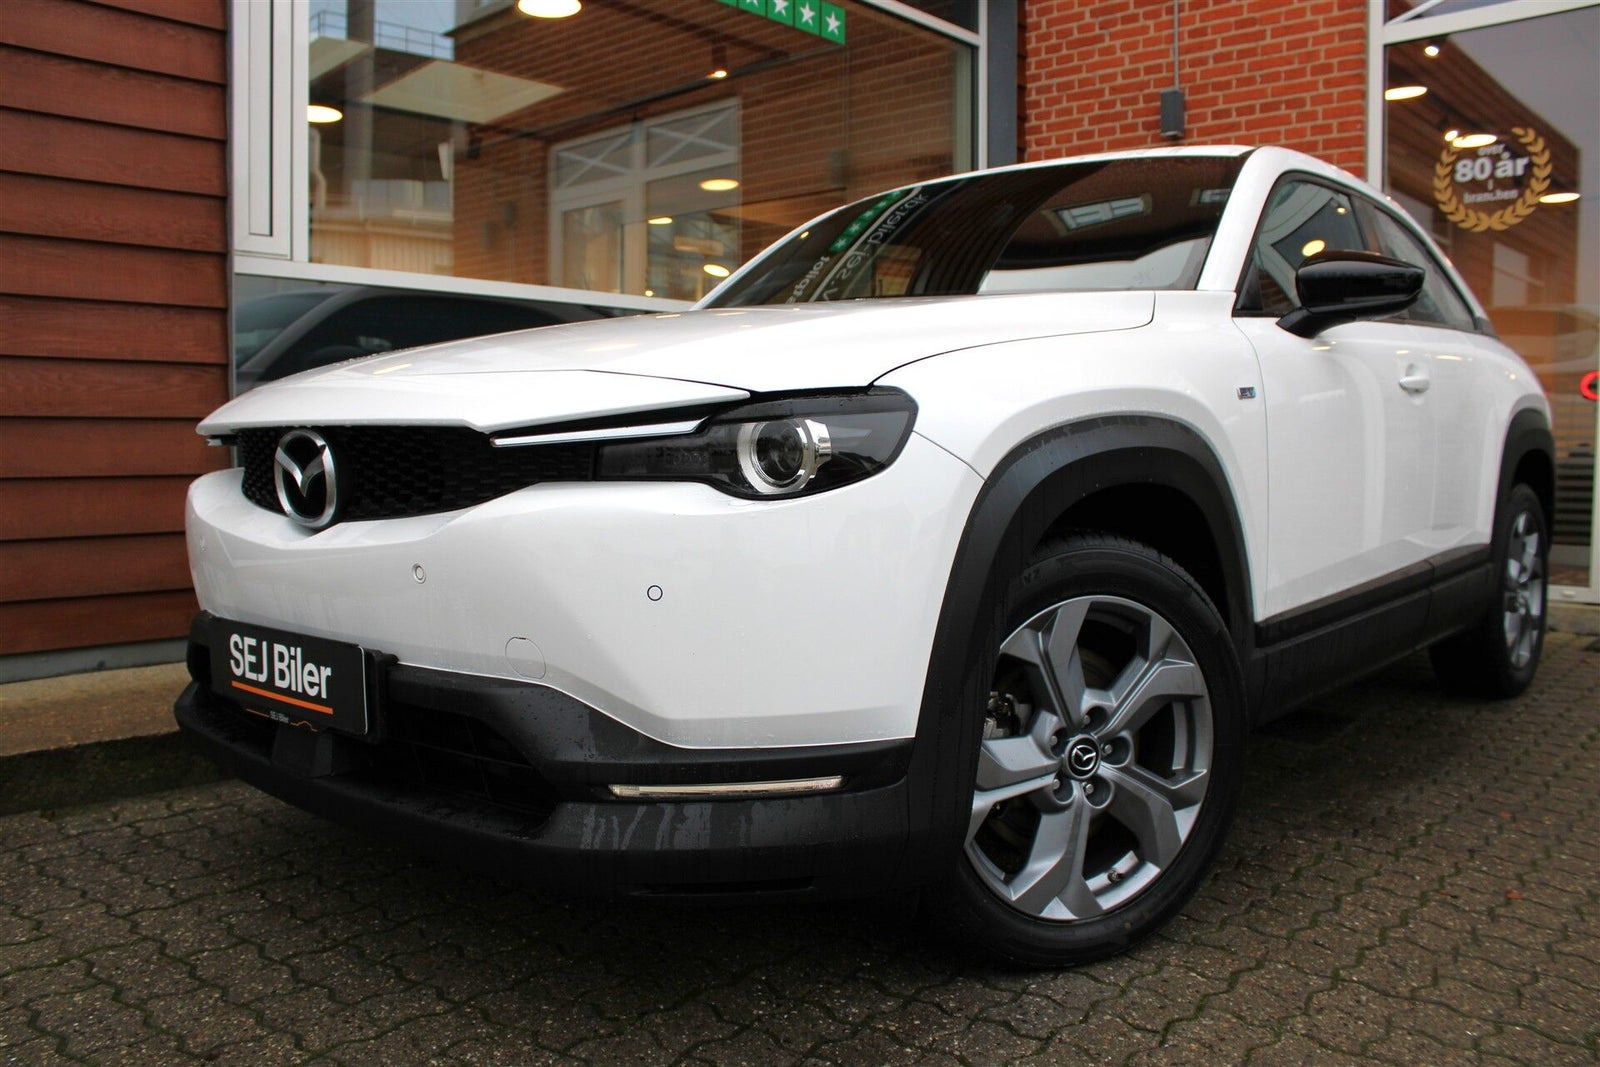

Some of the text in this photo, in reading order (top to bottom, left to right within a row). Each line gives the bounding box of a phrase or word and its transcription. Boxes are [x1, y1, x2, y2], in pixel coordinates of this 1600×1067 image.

[1455, 152, 1529, 182] 80 år
[229, 633, 332, 699] SEJ Biler
